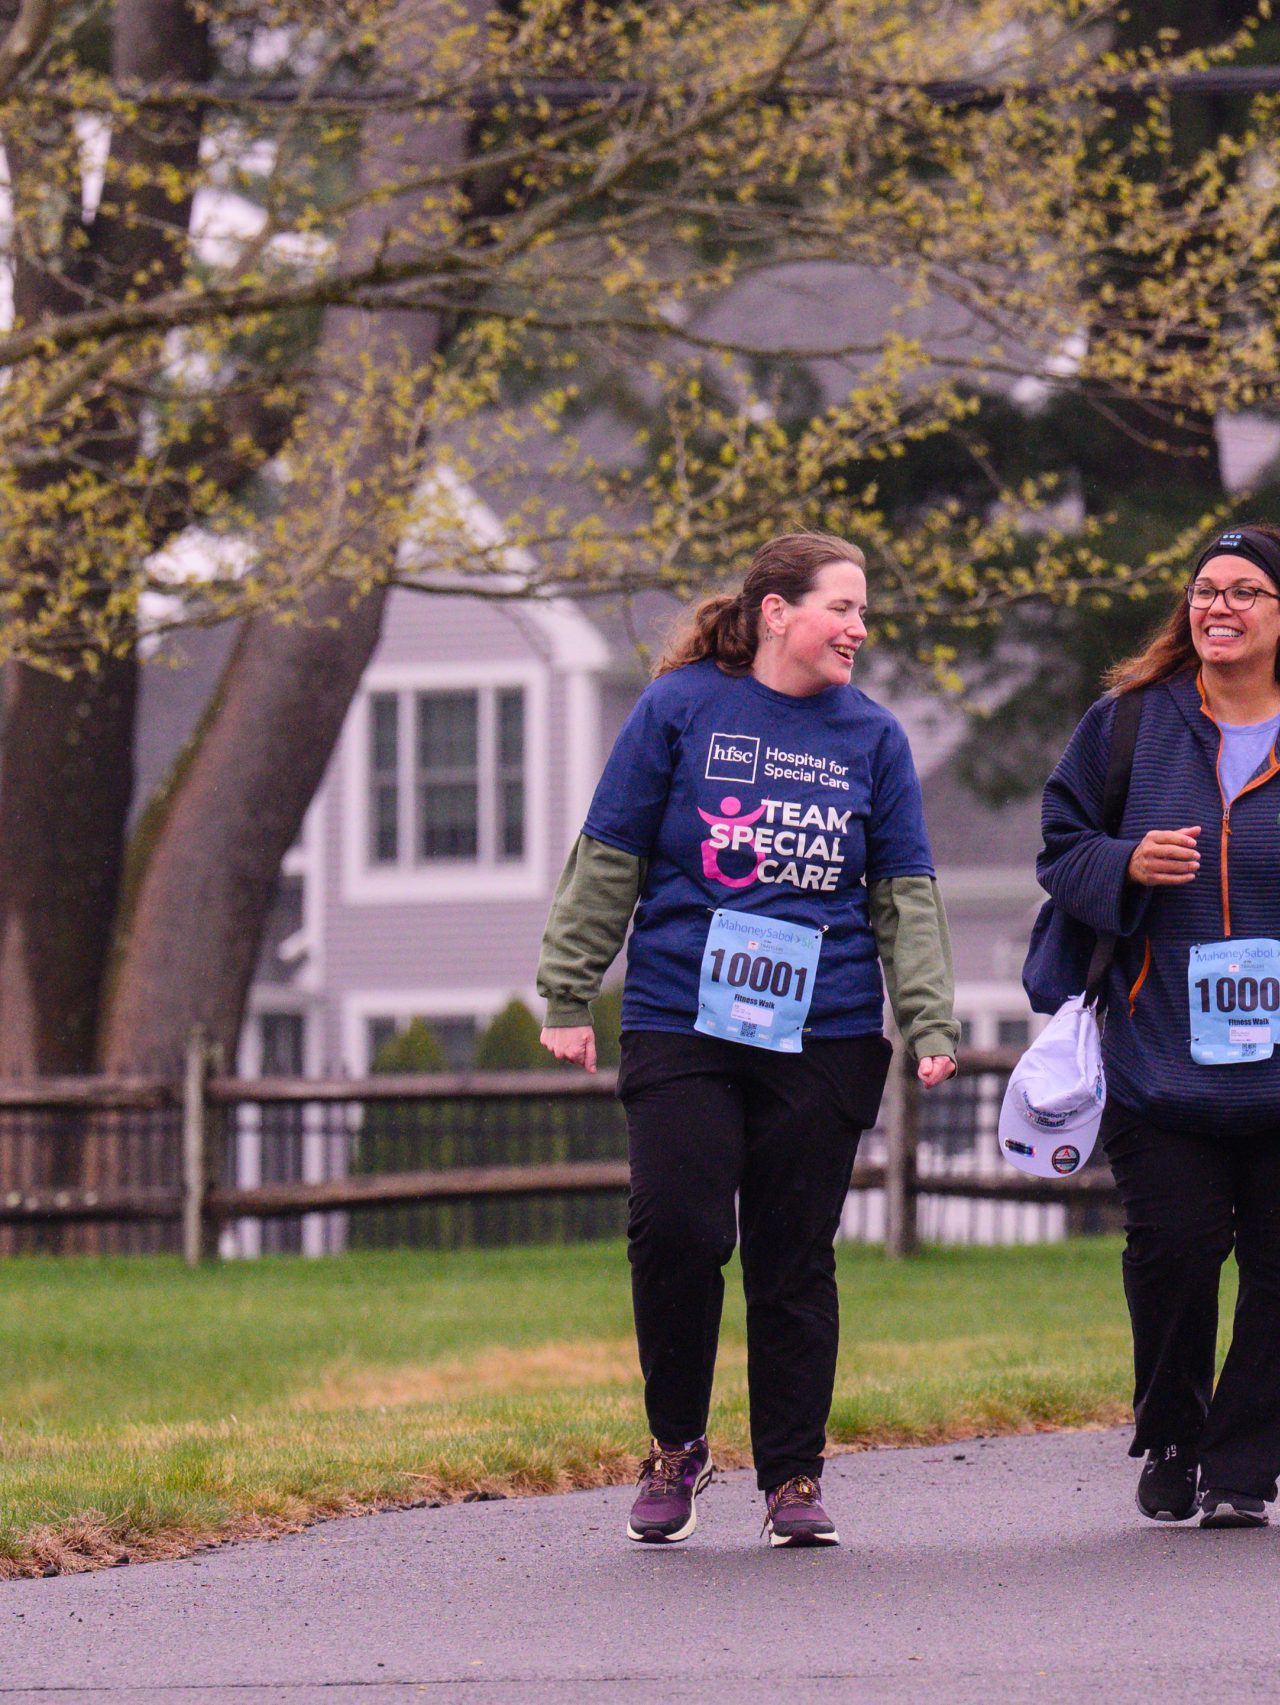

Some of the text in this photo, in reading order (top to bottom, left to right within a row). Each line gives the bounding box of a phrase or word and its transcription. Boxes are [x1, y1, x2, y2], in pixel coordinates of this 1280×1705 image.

[713, 744, 753, 763] hfsc
[766, 747, 848, 776] Hospital for
[764, 763, 850, 790] Special Care
[761, 799, 852, 834] TEAM
[709, 823, 845, 863] SPECIAL
[757, 859, 842, 891] CARE
[718, 918, 794, 943] MahoneySabol
[1196, 947, 1274, 962] MahoneySabol
[710, 948, 808, 1002] 10001
[734, 993, 775, 1009] Fitness Walk
[1228, 1017, 1270, 1026] Fitness Walk
